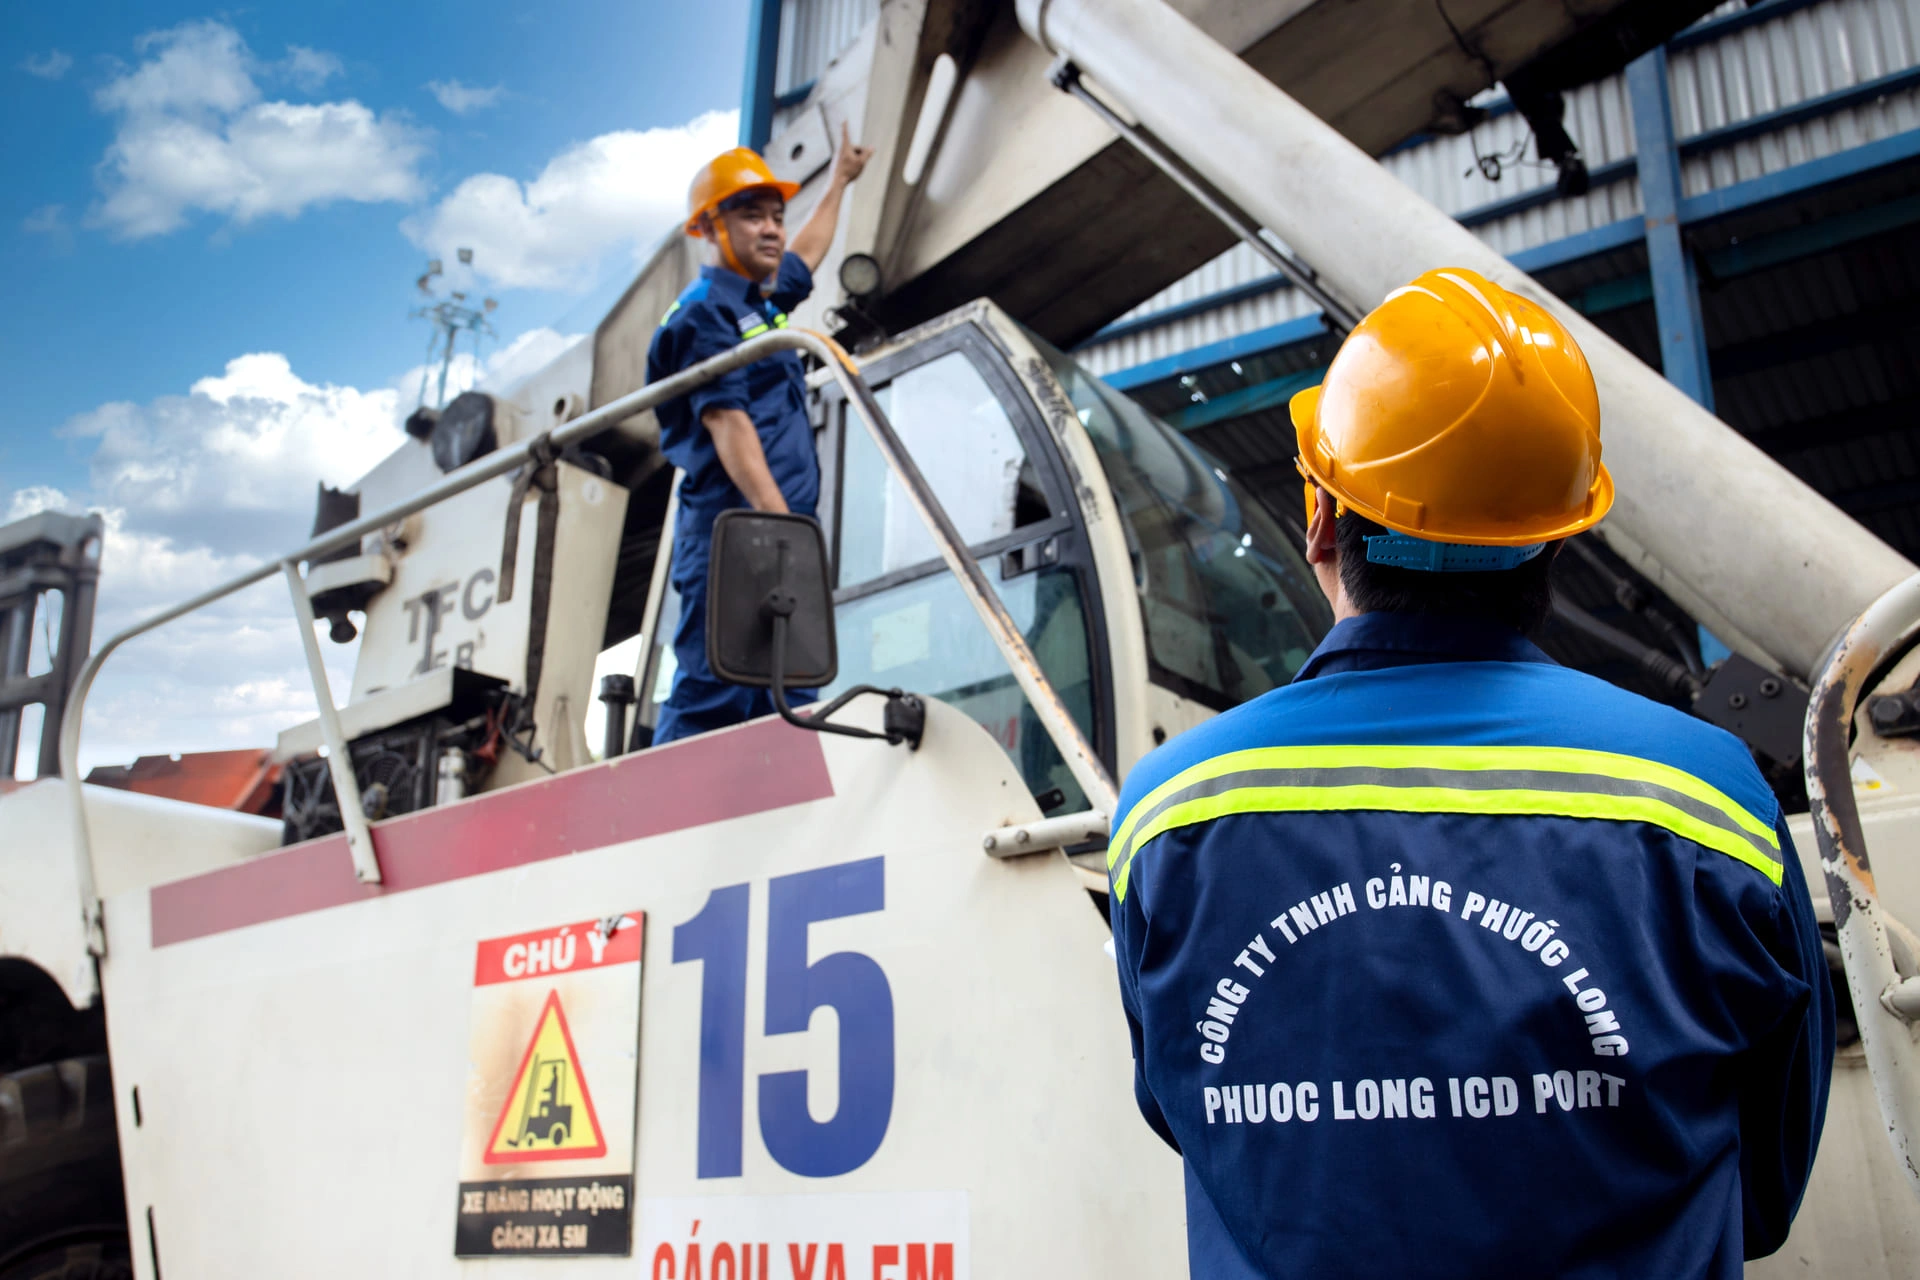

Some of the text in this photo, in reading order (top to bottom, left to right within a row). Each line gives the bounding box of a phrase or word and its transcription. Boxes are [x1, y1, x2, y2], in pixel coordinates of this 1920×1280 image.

[503, 926, 577, 978] CHÚ
[1196, 862, 1630, 1065] CÔNG TY TNHH CẢNG PHƯỚC LONG
[672, 855, 895, 1180] 15
[1203, 1069, 1626, 1124] PHUOC LONG ICD PORT
[461, 1191, 485, 1214] XE
[531, 1186, 576, 1217] HOẠT
[491, 1220, 589, 1250] CÁCH XA 5M
